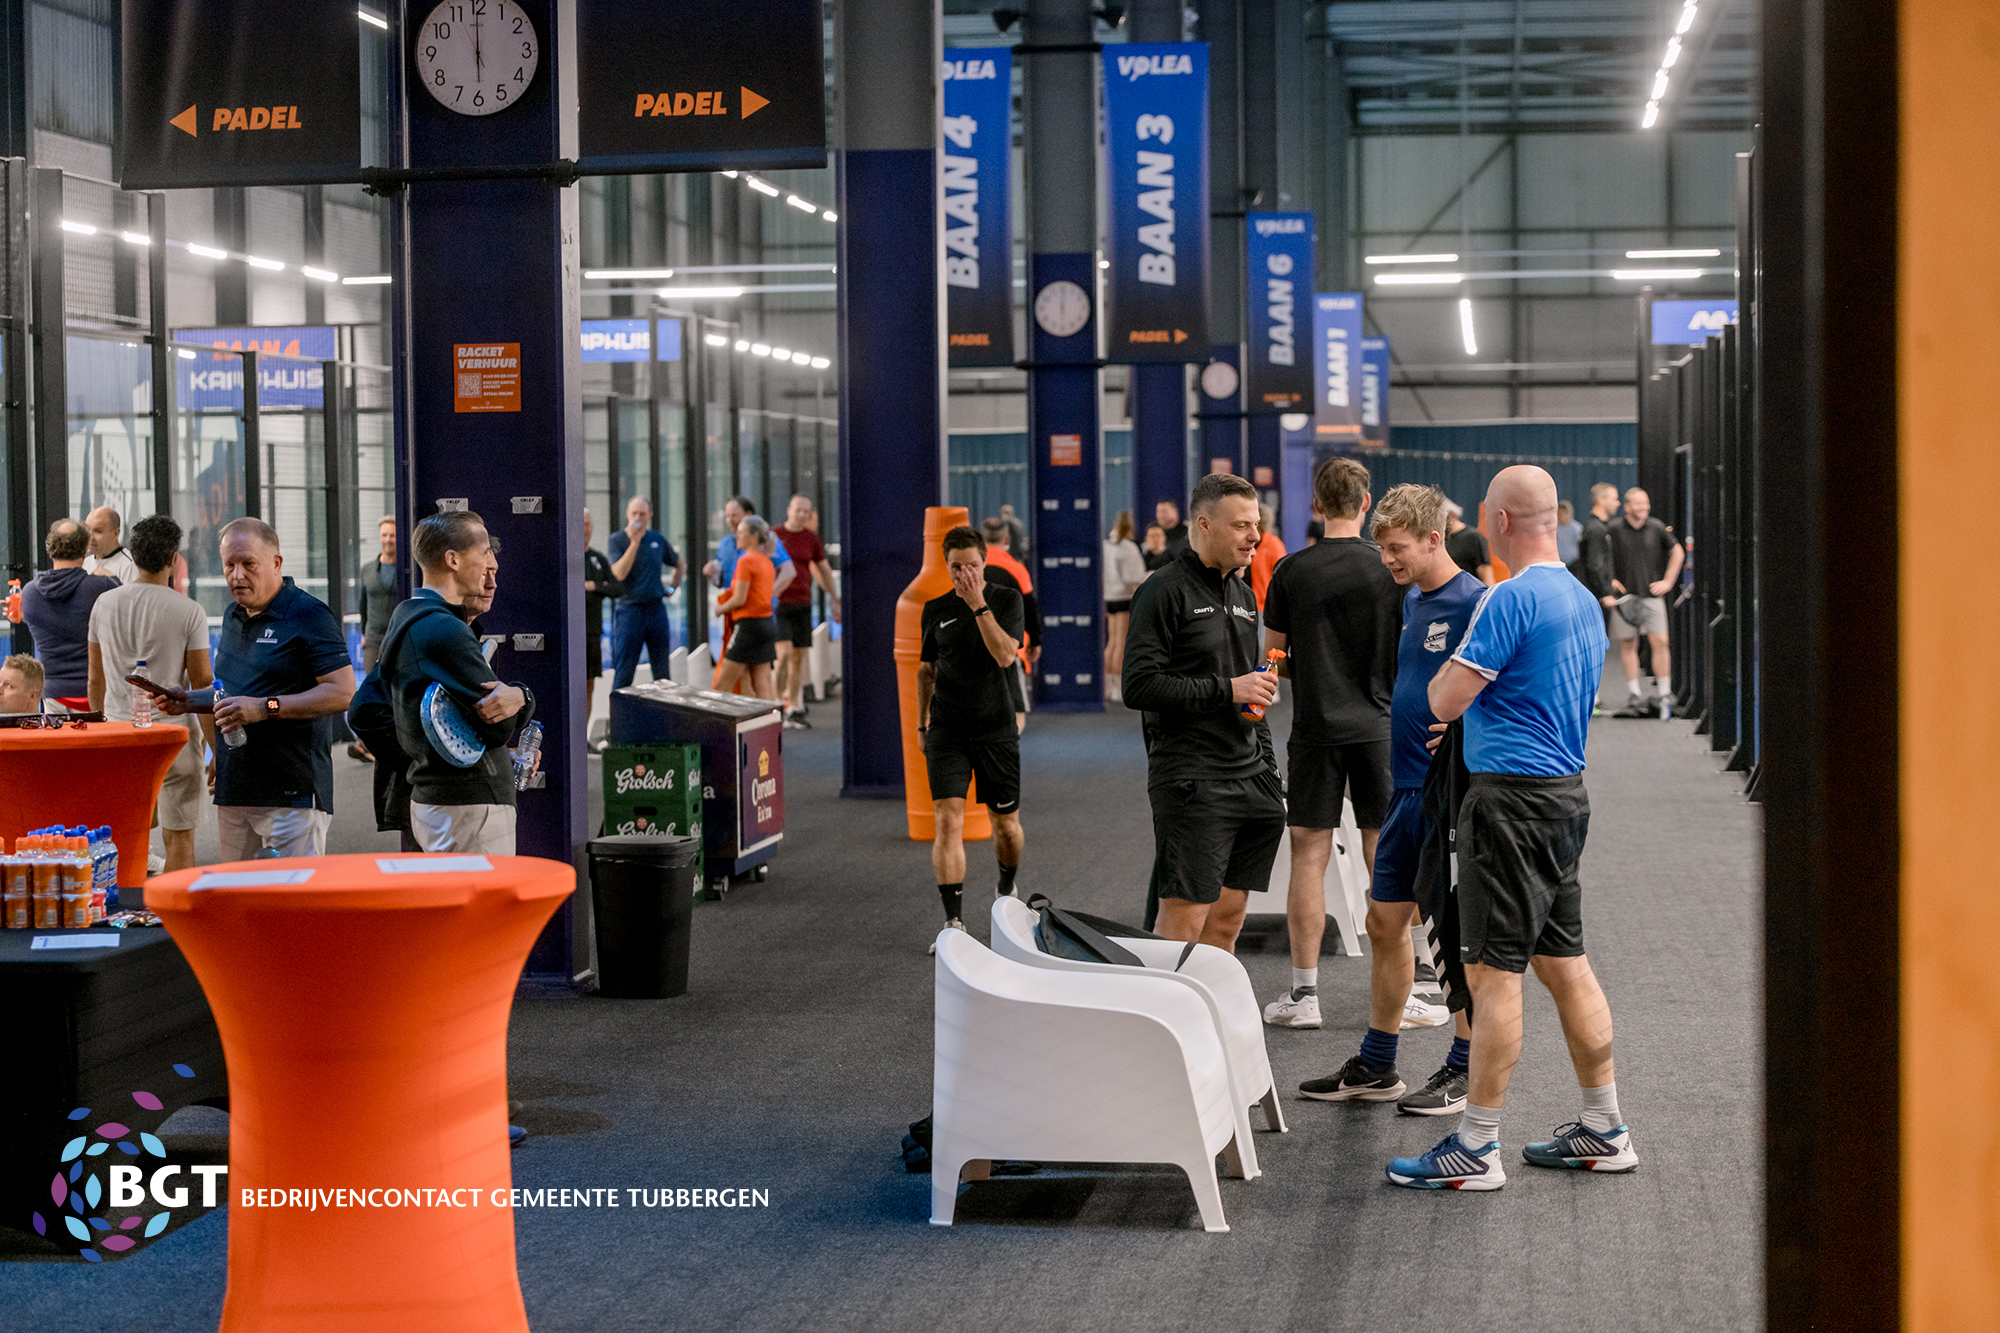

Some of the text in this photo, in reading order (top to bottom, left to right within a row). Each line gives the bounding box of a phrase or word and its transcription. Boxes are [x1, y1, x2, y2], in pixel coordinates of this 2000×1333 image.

[449, 6, 463, 22] 11
[470, 0, 486, 15] 12
[498, 4, 504, 20] 1
[433, 22, 451, 39] 10
[512, 17, 523, 34] 2
[425, 46, 437, 62] 9
[521, 42, 532, 59] 3
[434, 69, 446, 86] 8
[513, 66, 524, 83] 4
[943, 60, 997, 80] OLEA
[454, 85, 464, 102] 7
[473, 90, 485, 107] 6
[495, 84, 507, 101] 5
[635, 91, 727, 117] PADEL
[212, 105, 302, 131] PADEL
[943, 114, 980, 289] BAAN 4
[1135, 113, 1176, 286] BAAN 3
[1267, 253, 1293, 276] 6
[1267, 278, 1295, 366] BAAN
[458, 346, 504, 357] RACKET
[458, 358, 517, 369] VERHUUR
[1327, 341, 1349, 407] BAAN
[615, 768, 675, 794] Grolsch
[751, 777, 776, 807] Corona
